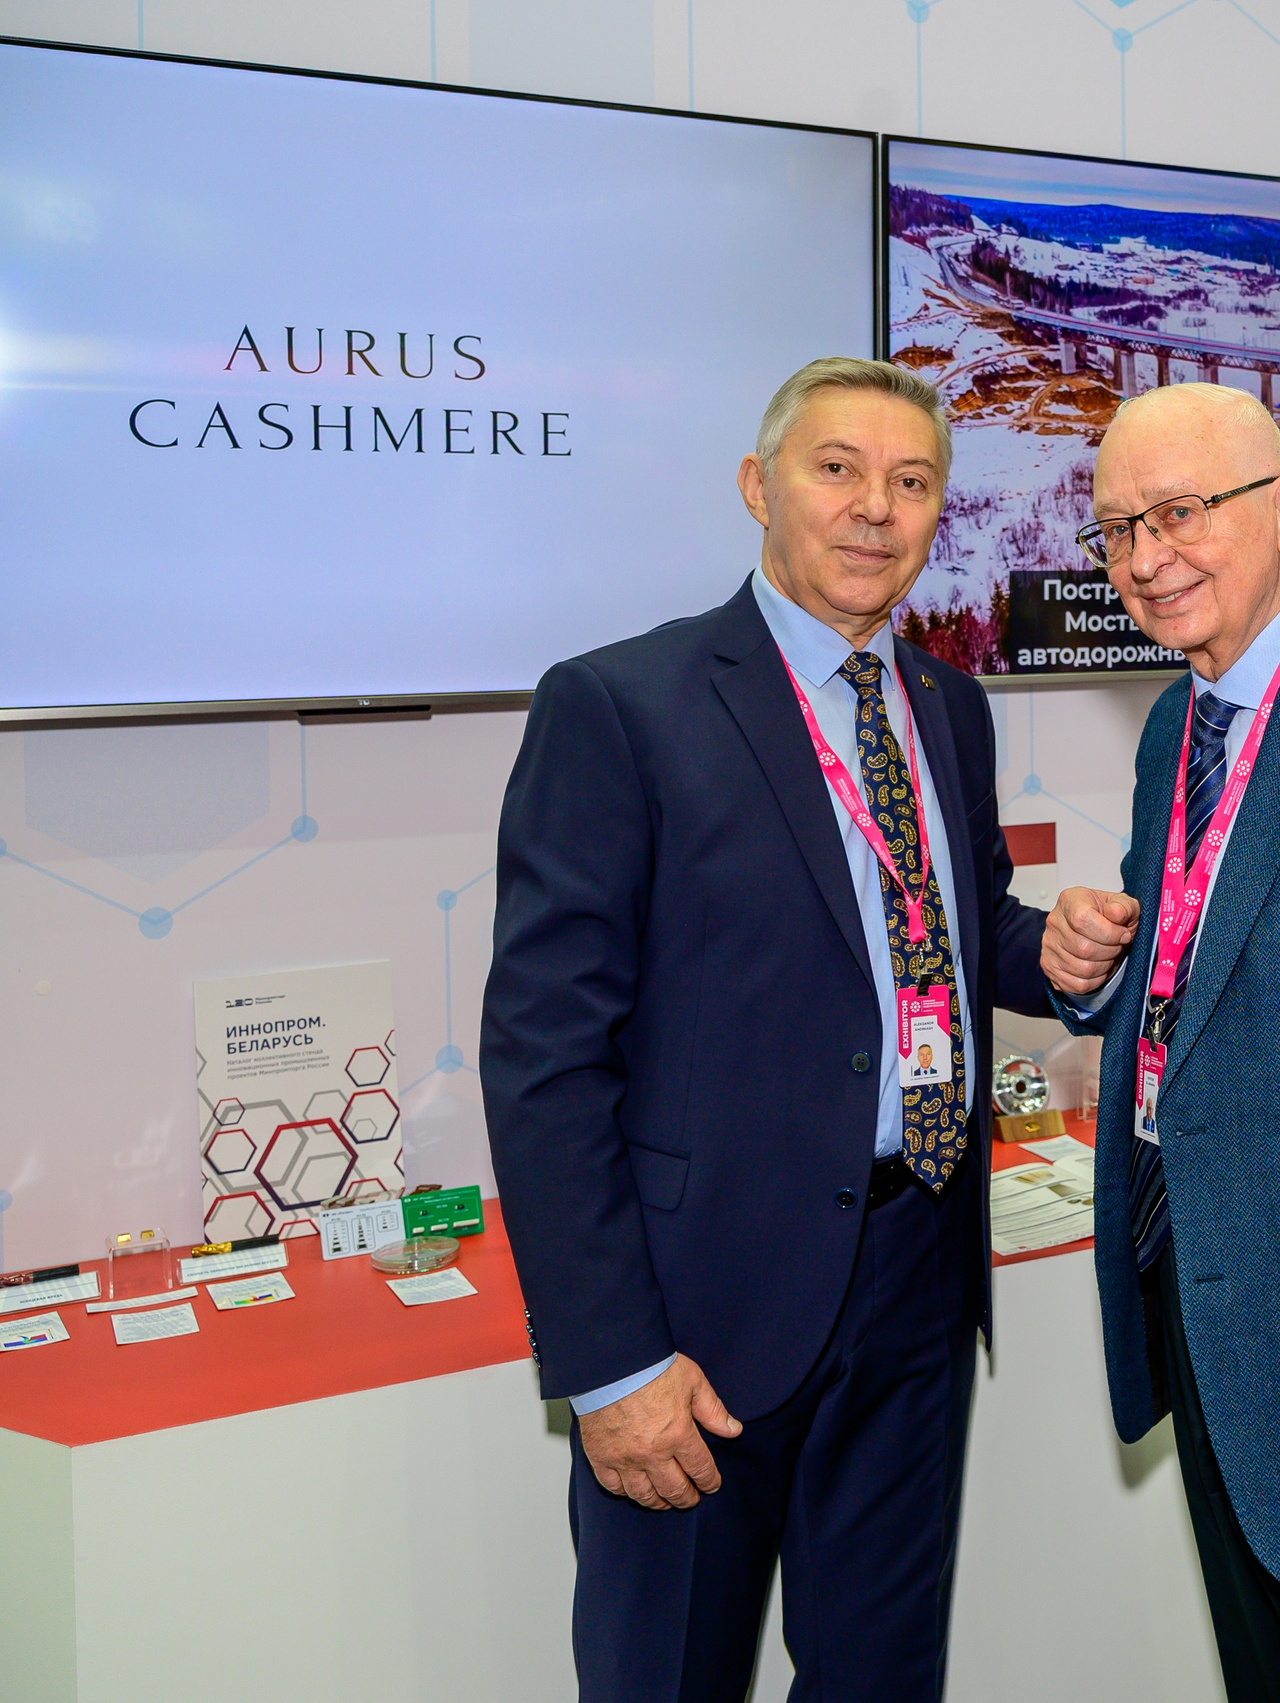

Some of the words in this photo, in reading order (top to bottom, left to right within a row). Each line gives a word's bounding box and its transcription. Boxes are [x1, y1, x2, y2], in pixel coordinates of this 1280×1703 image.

[222, 323, 486, 381] AURUS
[127, 398, 573, 457] CASHMERE
[226, 1016, 327, 1039] ИННОПРОМ.
[227, 1033, 314, 1055] БЕЛАРУСЬ
[901, 999, 910, 1049] EXHIBITOR
